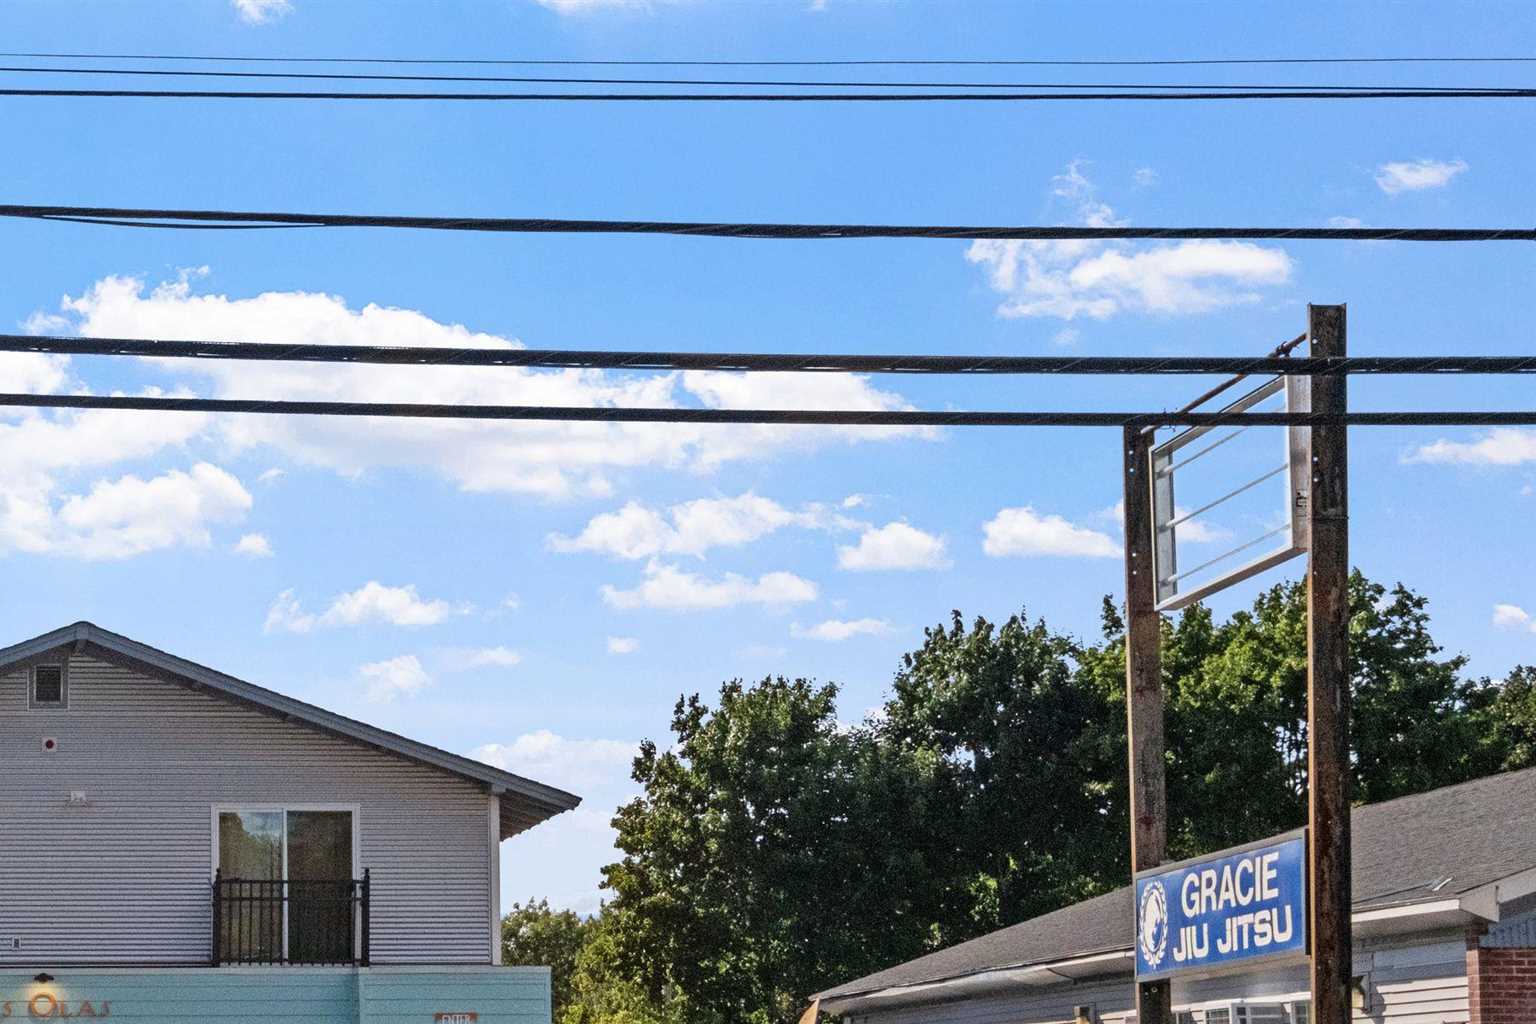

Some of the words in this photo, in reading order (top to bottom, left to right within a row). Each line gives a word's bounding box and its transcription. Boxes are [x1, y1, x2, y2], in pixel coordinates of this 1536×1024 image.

[1181, 852, 1279, 919] GRACIE
[1173, 923, 1209, 962] JIU
[1217, 905, 1293, 954] JITSU
